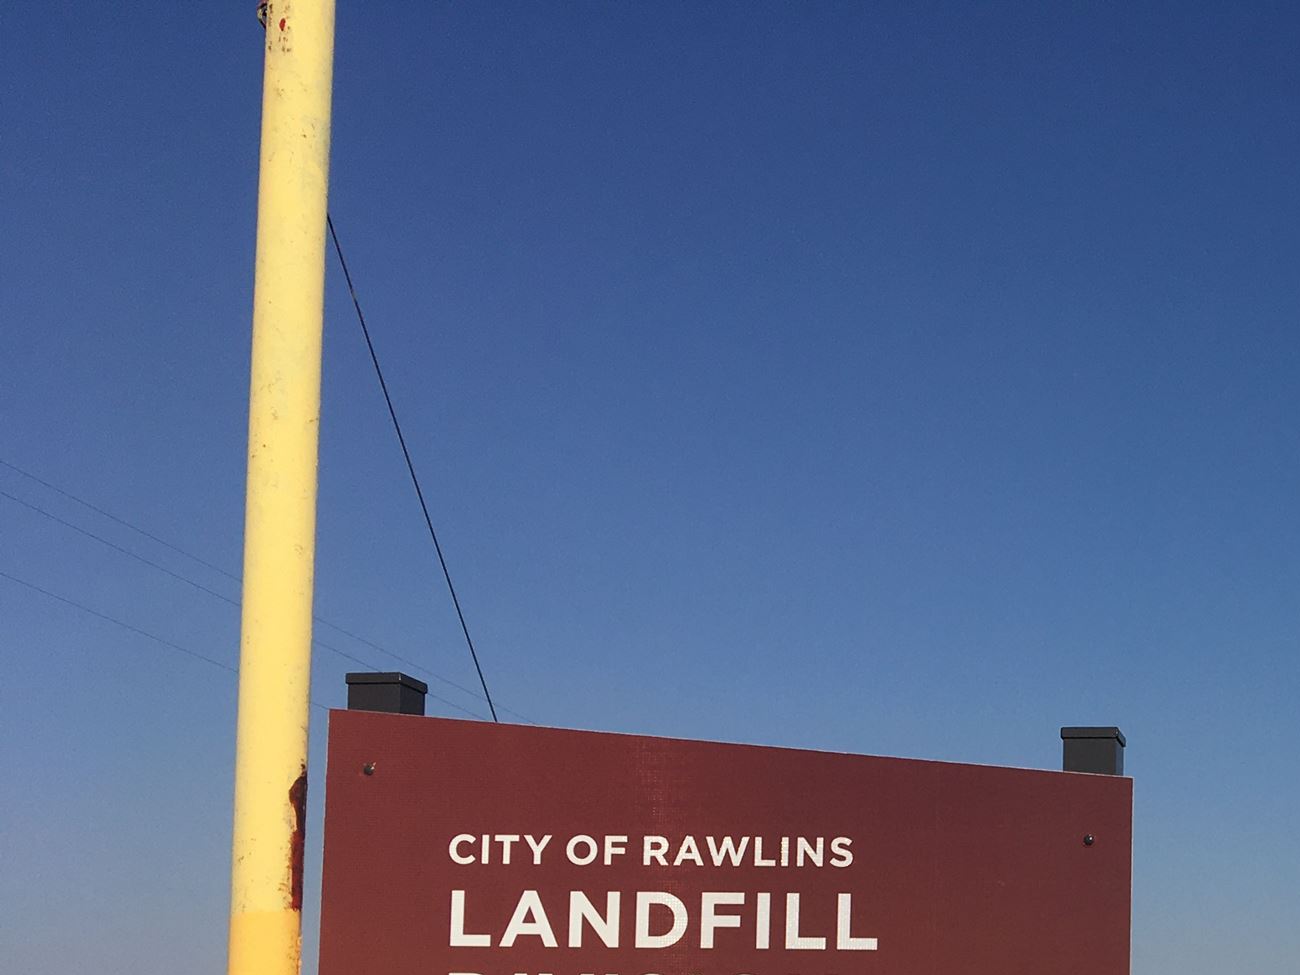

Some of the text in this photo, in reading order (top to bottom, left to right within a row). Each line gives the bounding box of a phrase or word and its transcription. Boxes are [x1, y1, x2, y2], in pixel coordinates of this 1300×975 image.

[450, 834, 855, 868] CITY OF RAWLINS
[450, 890, 879, 950] LANDFILL
